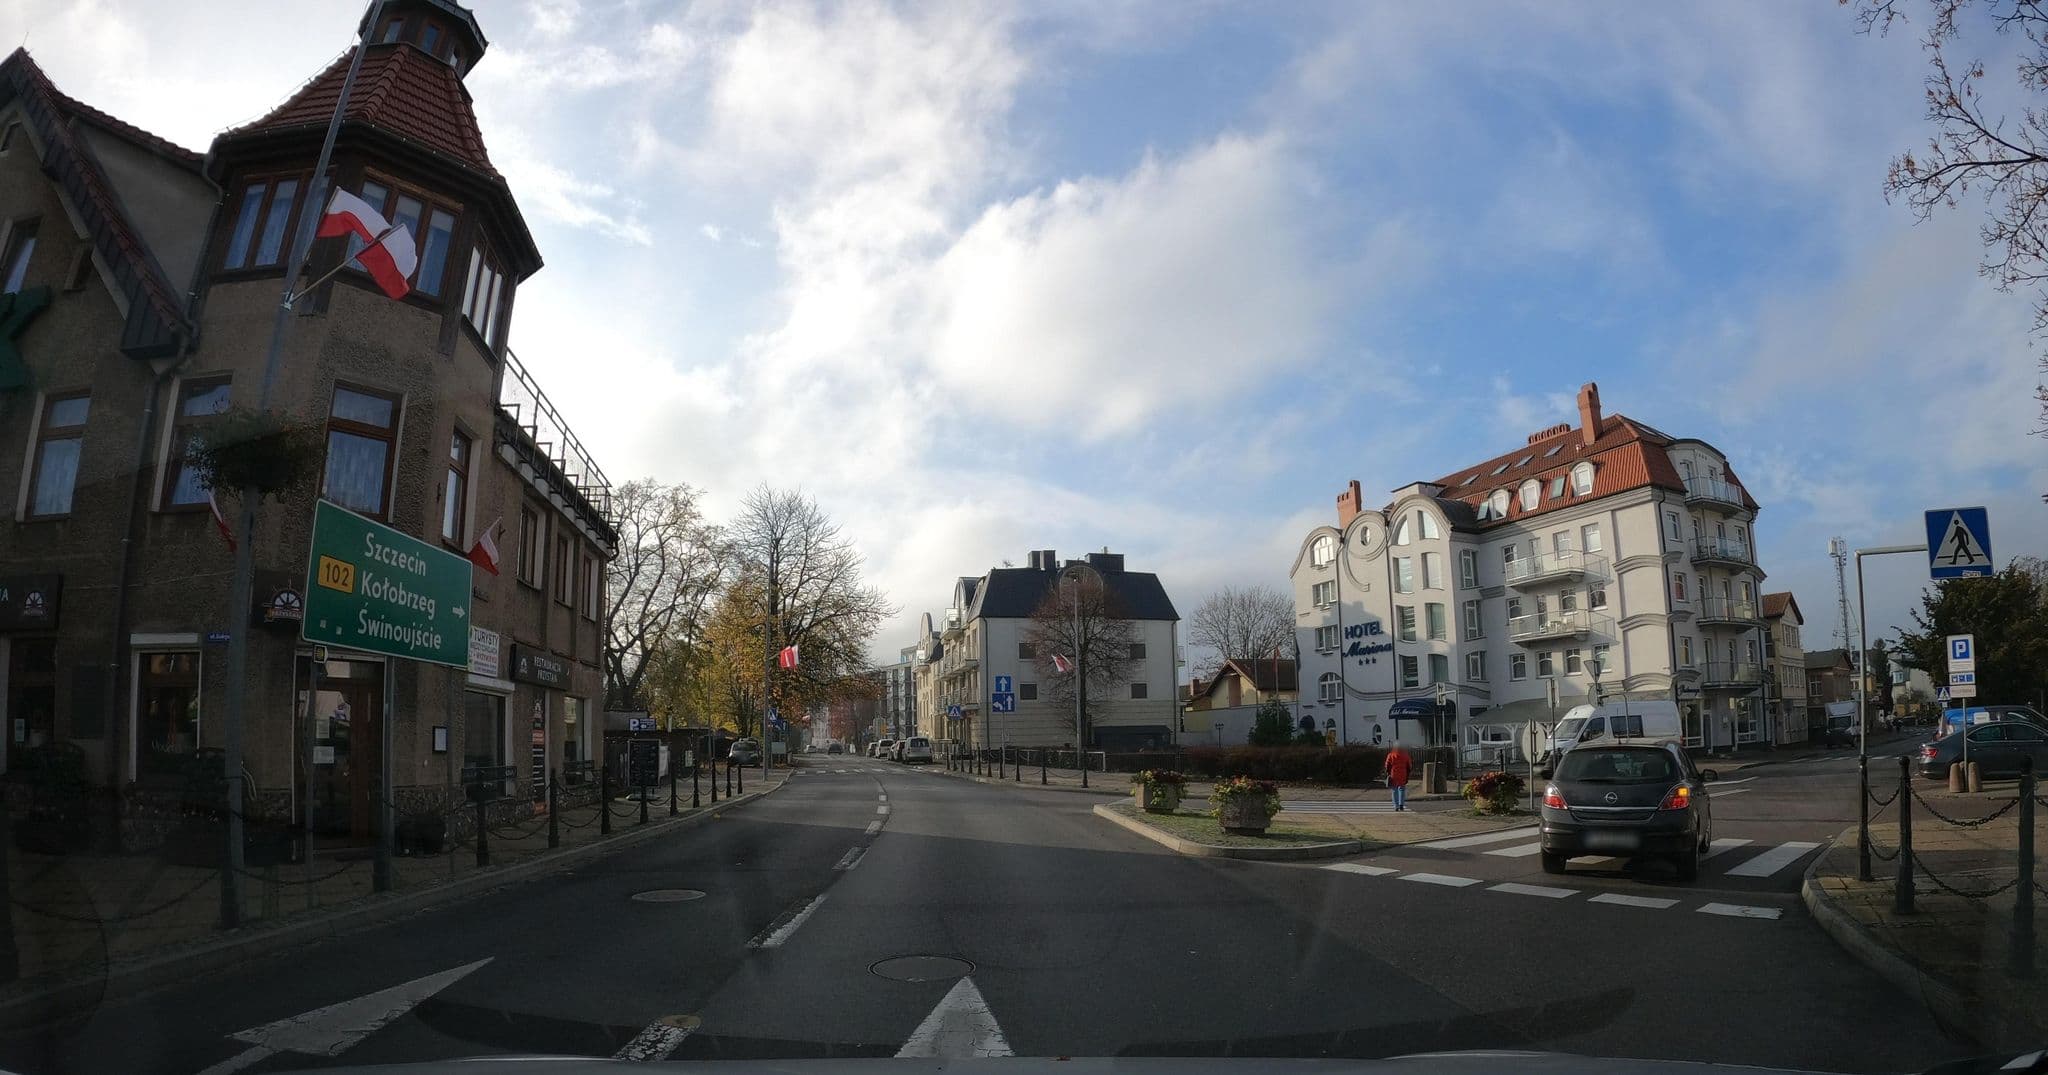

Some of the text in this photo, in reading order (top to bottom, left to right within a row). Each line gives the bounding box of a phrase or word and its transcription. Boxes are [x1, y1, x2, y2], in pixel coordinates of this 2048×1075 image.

[364, 532, 427, 576] Szczecin
[325, 562, 350, 586] 102
[361, 570, 436, 620] Kołobrzeg
[357, 602, 442, 650] Świnoujście
[1344, 621, 1384, 639] HOTEL
[1342, 641, 1392, 657] Marina
[1955, 641, 1967, 658] P
